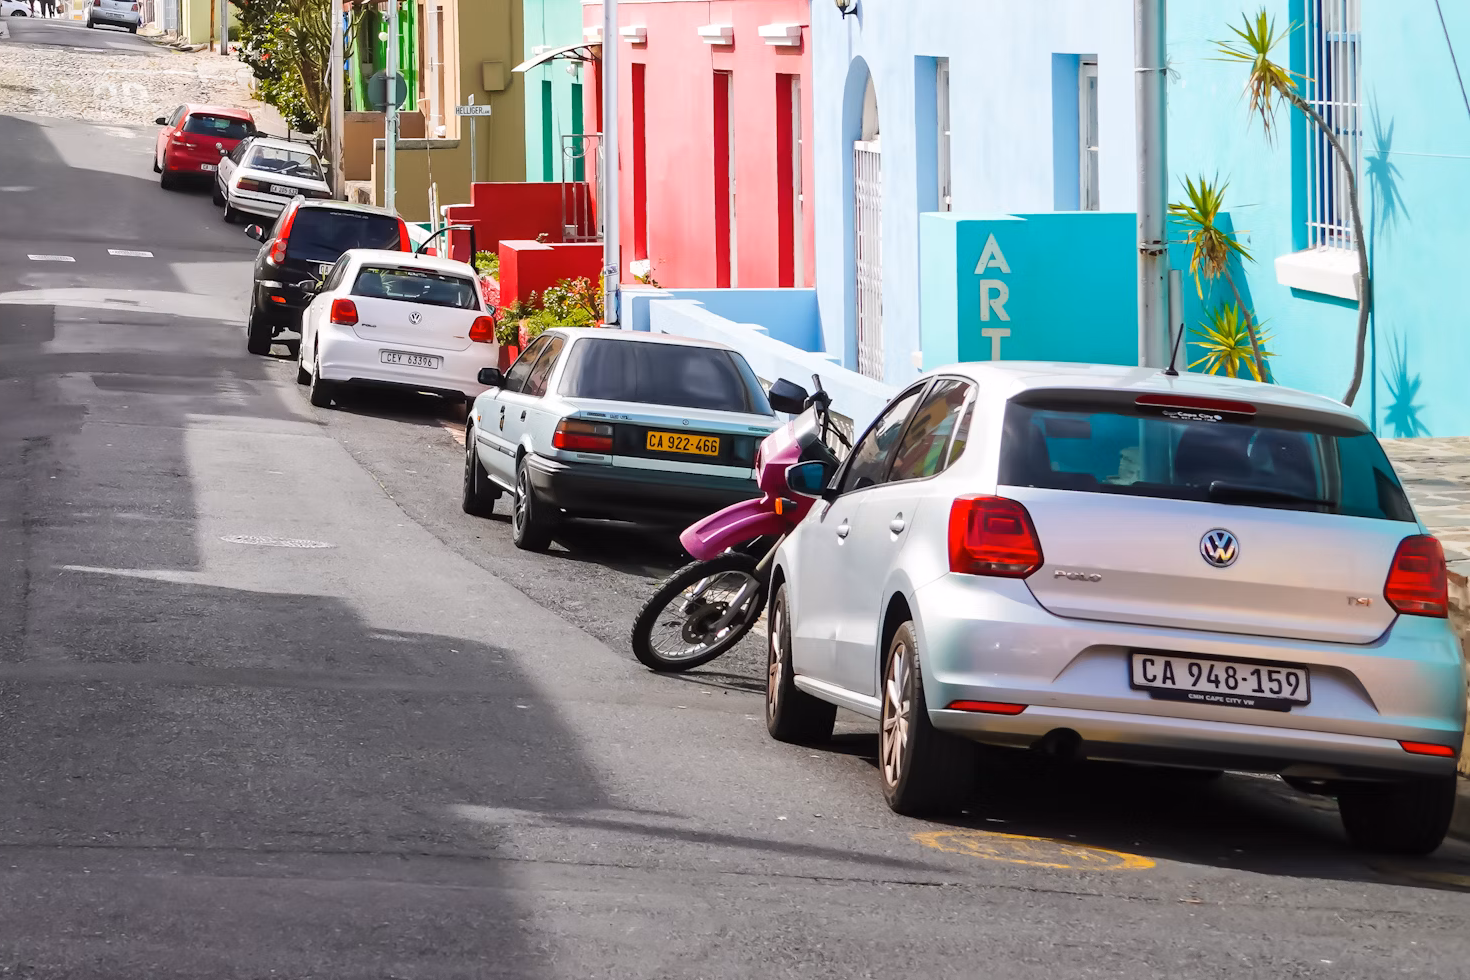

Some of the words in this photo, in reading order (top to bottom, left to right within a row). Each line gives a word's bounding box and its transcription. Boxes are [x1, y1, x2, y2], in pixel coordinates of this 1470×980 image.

[455, 106, 483, 115] HELLIGER
[974, 232, 1011, 361] ART
[387, 353, 402, 363] CEY
[407, 355, 432, 367] 63396
[649, 434, 663, 449] CA
[667, 435, 718, 453] 922-466
[1054, 569, 1102, 582] POLO
[1142, 658, 1176, 685] CA
[1187, 662, 1300, 697] 948-159
